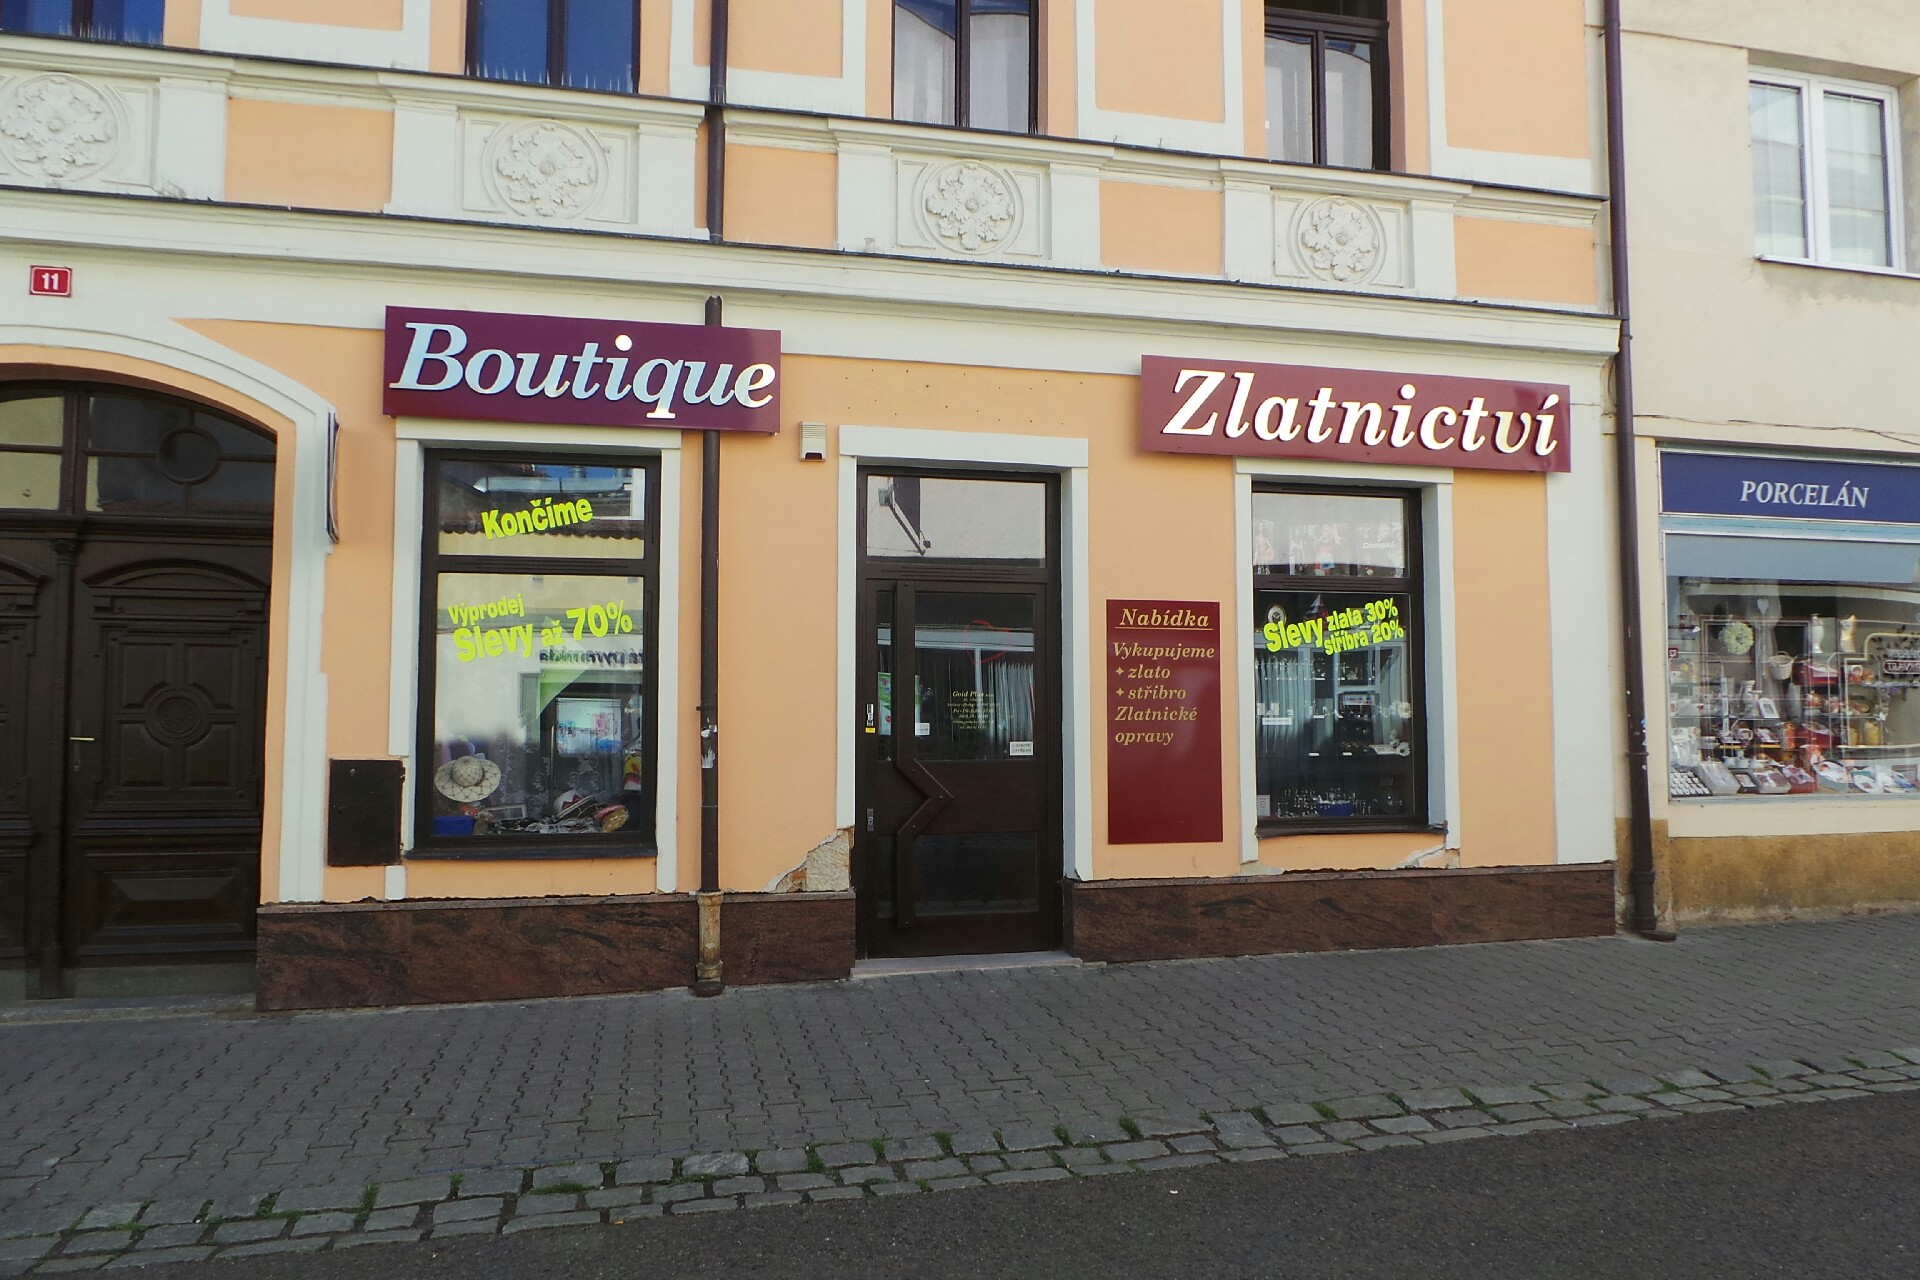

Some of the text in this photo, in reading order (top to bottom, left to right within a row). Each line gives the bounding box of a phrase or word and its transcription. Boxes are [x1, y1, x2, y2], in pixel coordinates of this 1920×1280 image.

[41, 272, 59, 290] 11
[388, 322, 777, 419] Boutique
[1161, 368, 1560, 457] Zlatnictví
[1739, 480, 1870, 509] PORCELÁN
[481, 497, 594, 540] Končíme
[448, 593, 525, 628] Výprodej
[1119, 608, 1210, 627] Nabídka
[1263, 597, 1399, 652] Slevy zlata 30%
[453, 600, 633, 663] Slevy až 70%
[1323, 619, 1404, 656] stříbra 20%
[1112, 642, 1215, 661] Vykupujeme
[1127, 664, 1172, 679] zlato
[1127, 685, 1187, 700] stříbro
[1115, 706, 1198, 721] Zlatnické
[1115, 731, 1174, 746] opravy
